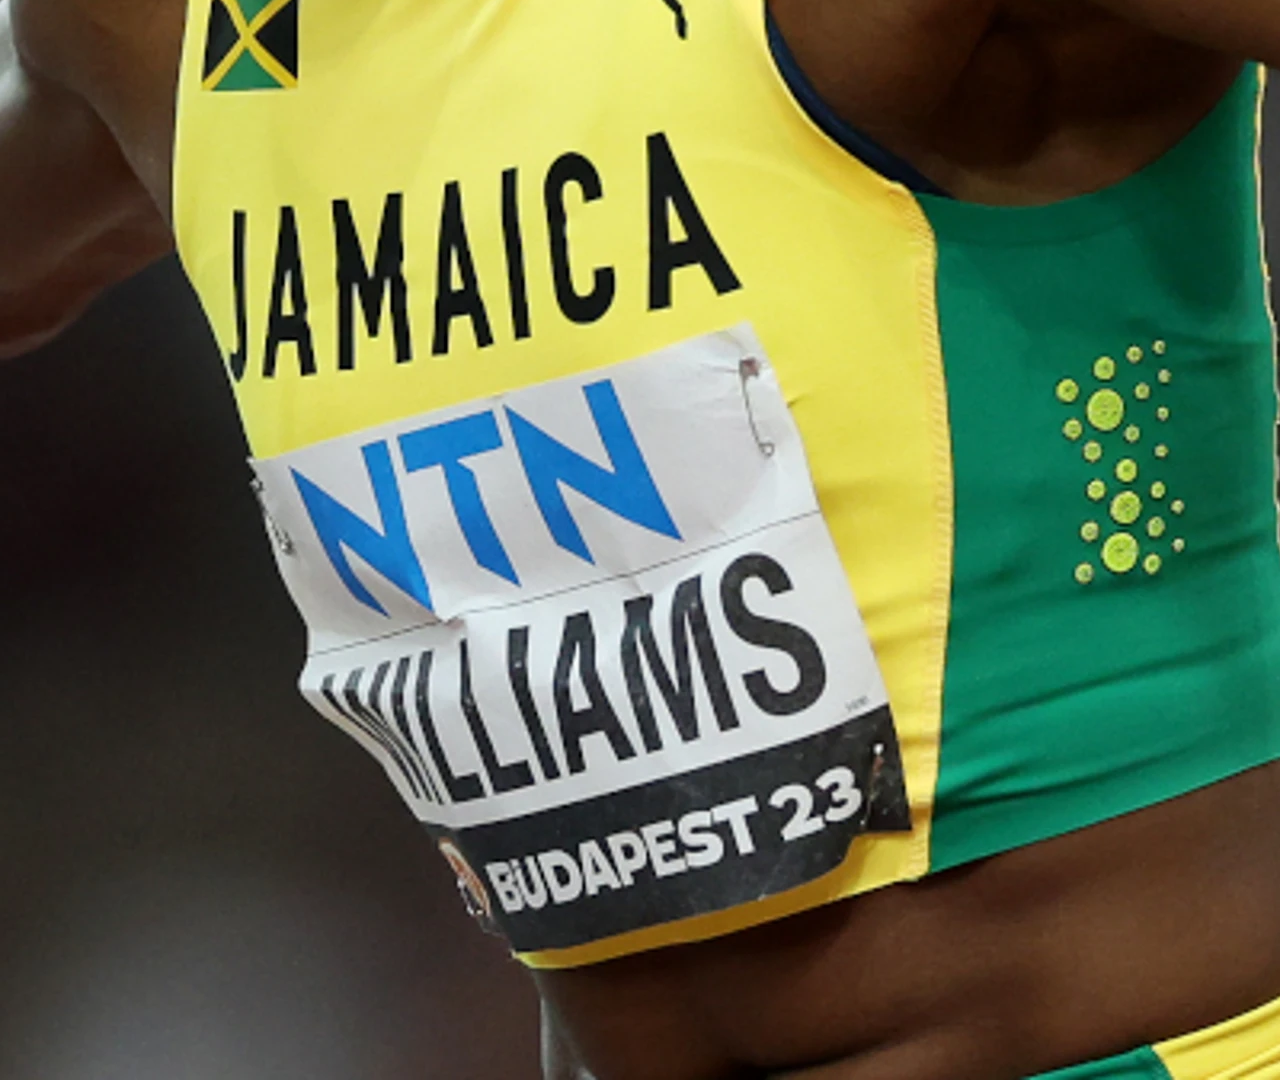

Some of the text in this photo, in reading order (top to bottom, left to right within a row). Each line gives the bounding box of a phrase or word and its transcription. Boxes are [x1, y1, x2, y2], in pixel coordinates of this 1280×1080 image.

[229, 132, 741, 382] JAMAICA
[291, 379, 682, 618] NTN
[321, 554, 827, 805] WILLIAMS
[485, 766, 863, 914] BUDAPEST 23
